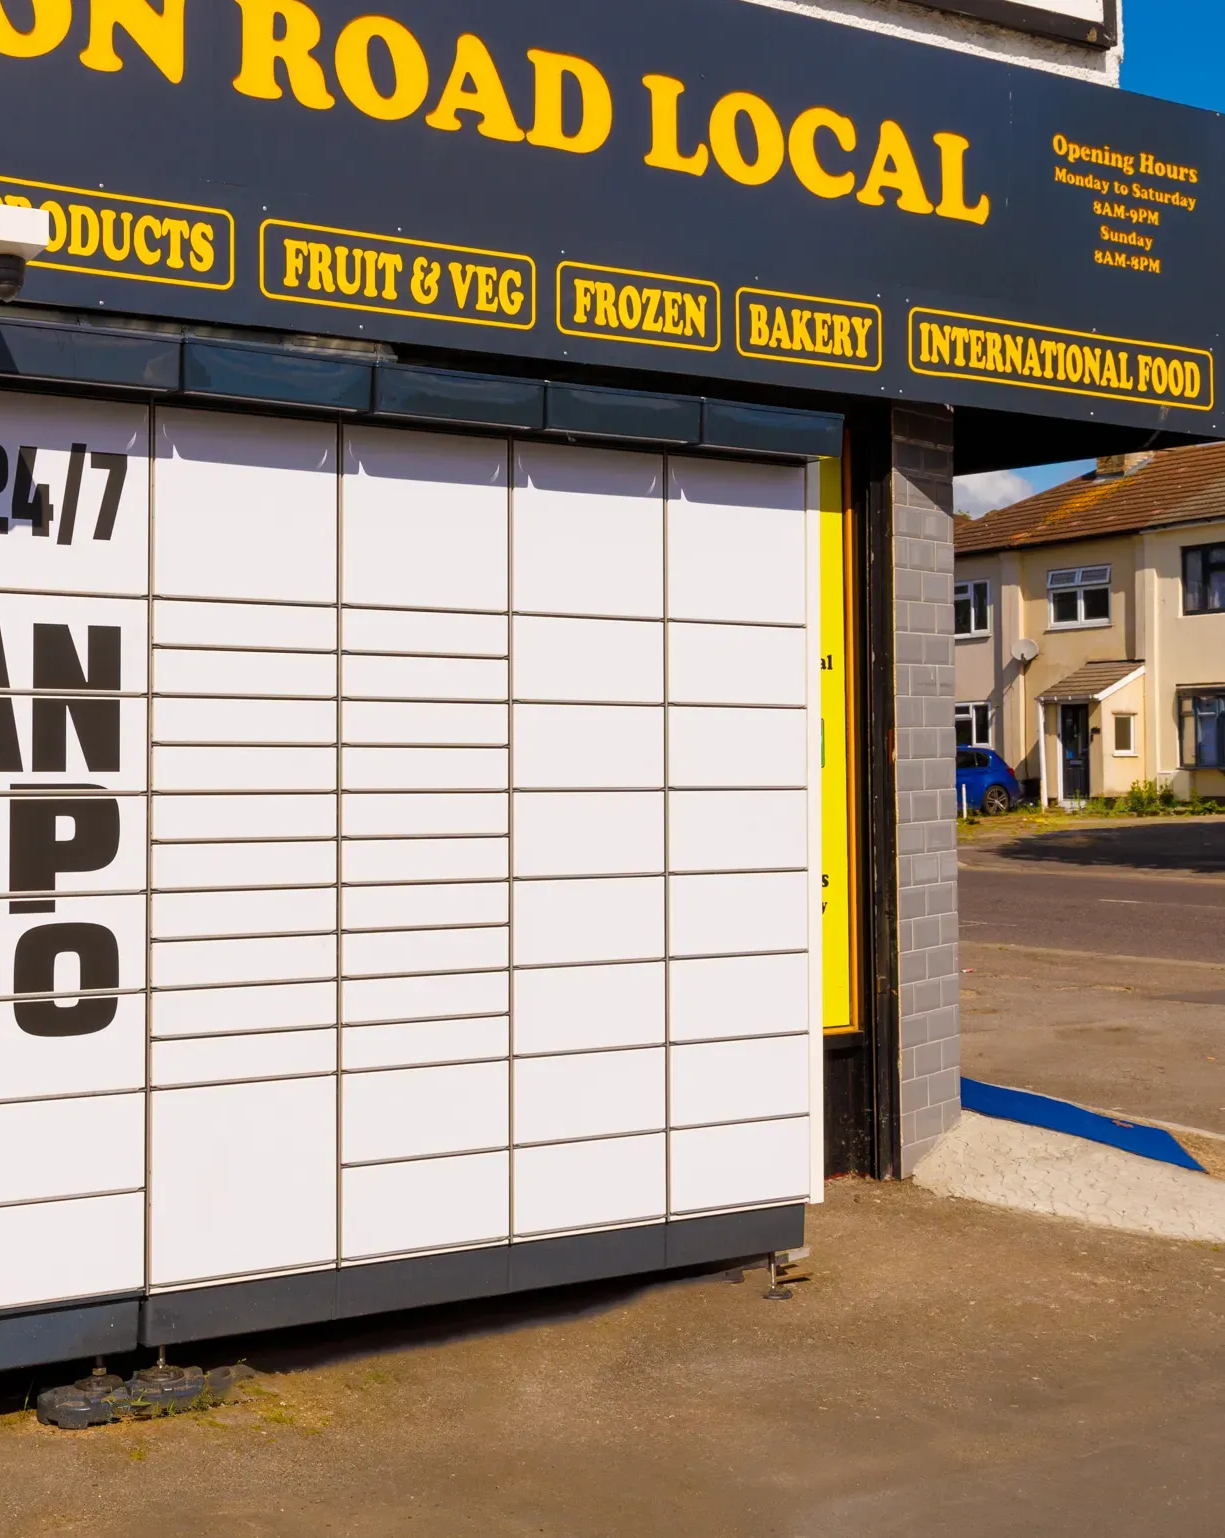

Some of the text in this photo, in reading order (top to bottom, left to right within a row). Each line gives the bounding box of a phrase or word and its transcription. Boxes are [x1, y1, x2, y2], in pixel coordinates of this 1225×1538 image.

[232, 0, 614, 154] ROAD
[642, 73, 990, 225] LOCAL
[1052, 134, 1199, 183] Opening Hours
[1054, 166, 1197, 211] Monday to Saturday
[1093, 201, 1160, 225] 8AM-9PM
[1094, 250, 1161, 273] 8AM-8PM
[1100, 225, 1153, 250] Sunday
[283, 238, 525, 315] FRUIT & VEG
[573, 278, 708, 338] FROZEN
[748, 303, 872, 358] BAKERY
[919, 322, 1201, 398] INTERNATIONAL FOOD
